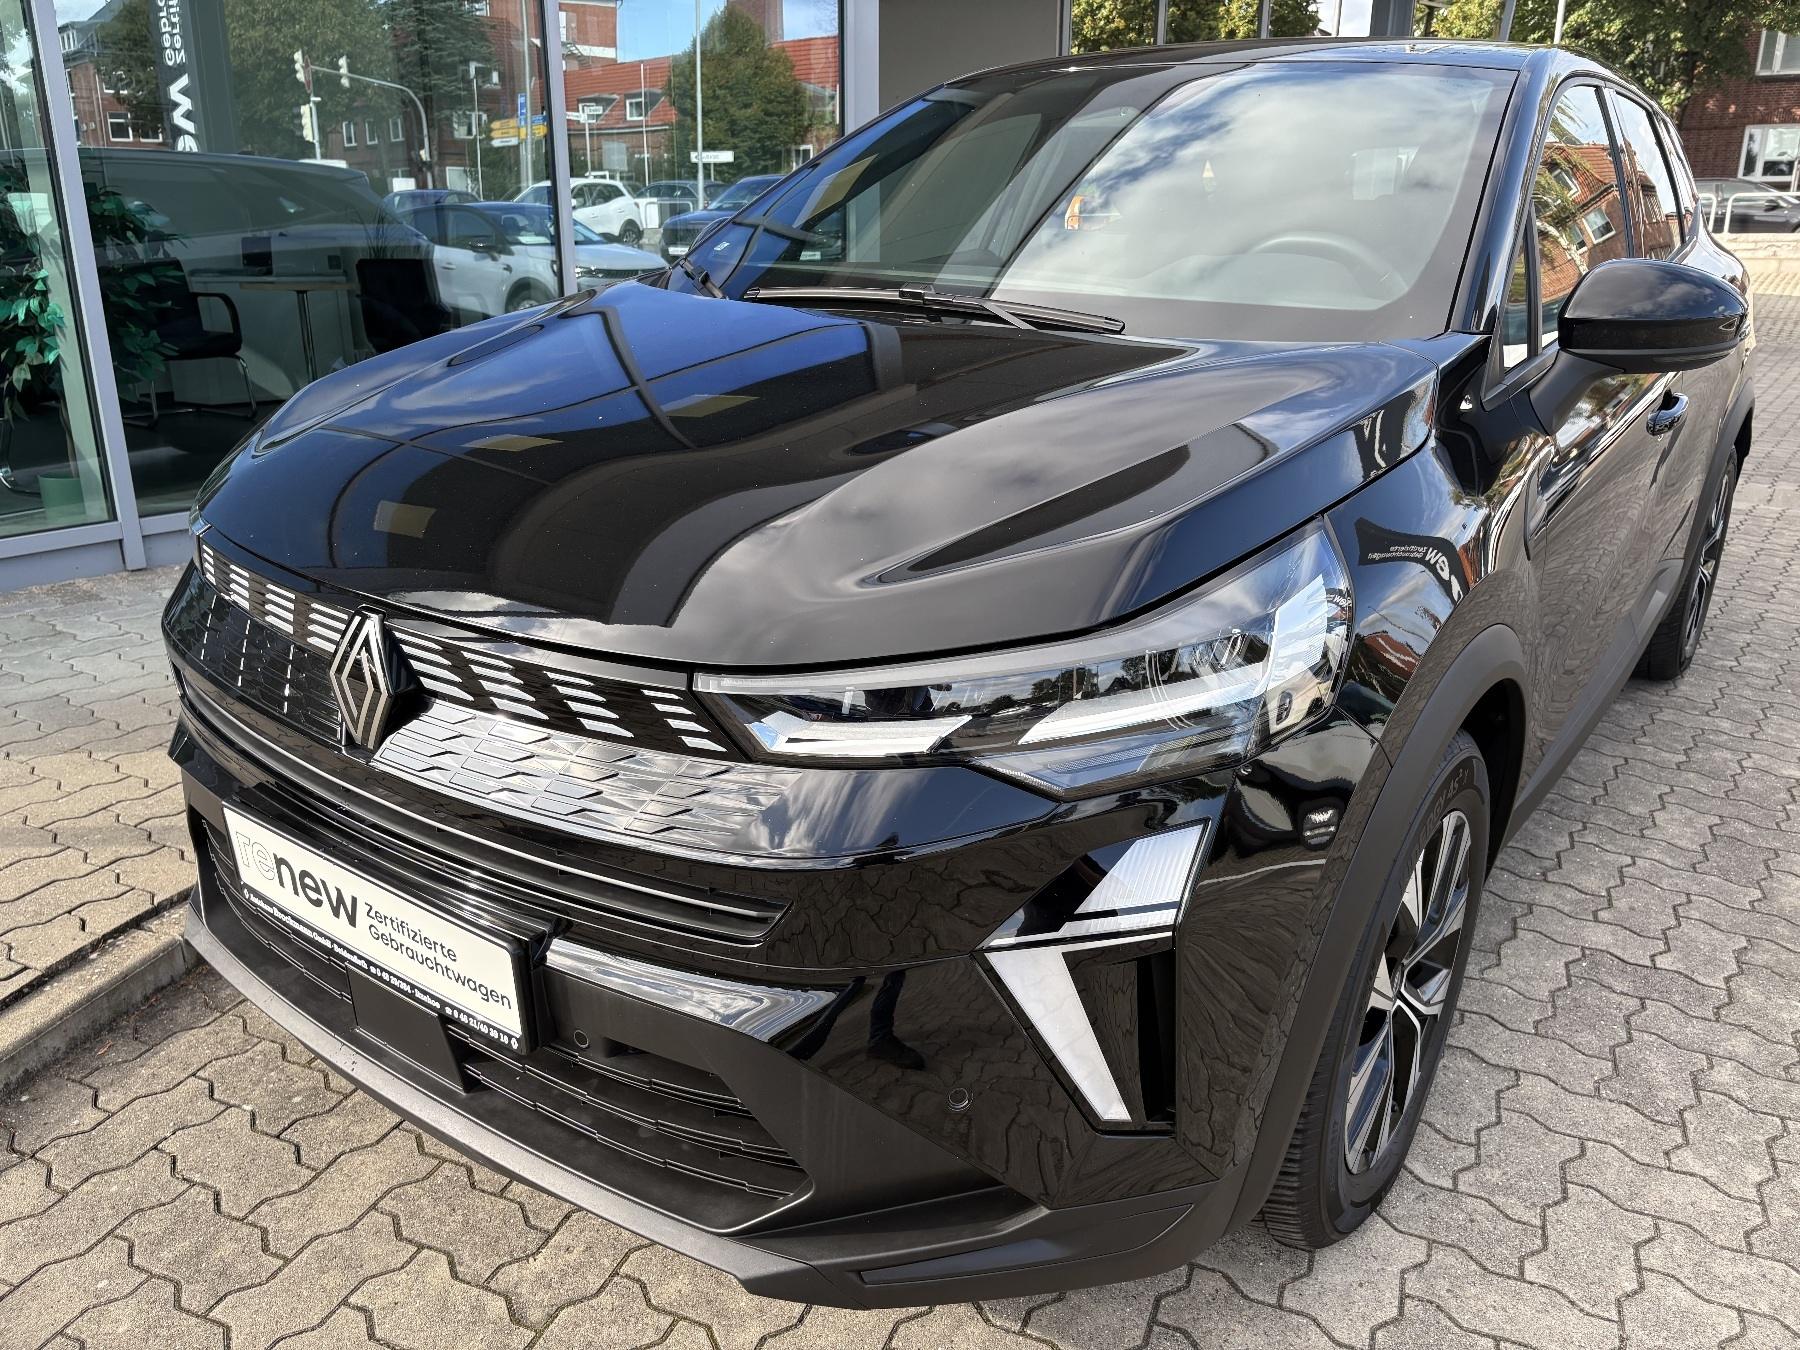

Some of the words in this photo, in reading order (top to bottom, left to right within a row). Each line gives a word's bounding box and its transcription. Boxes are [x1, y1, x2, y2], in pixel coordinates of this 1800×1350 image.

[235, 831, 358, 928] renew
[364, 901, 458, 963] Zertifizierte
[368, 923, 512, 1010] Gebrauchtwagen
